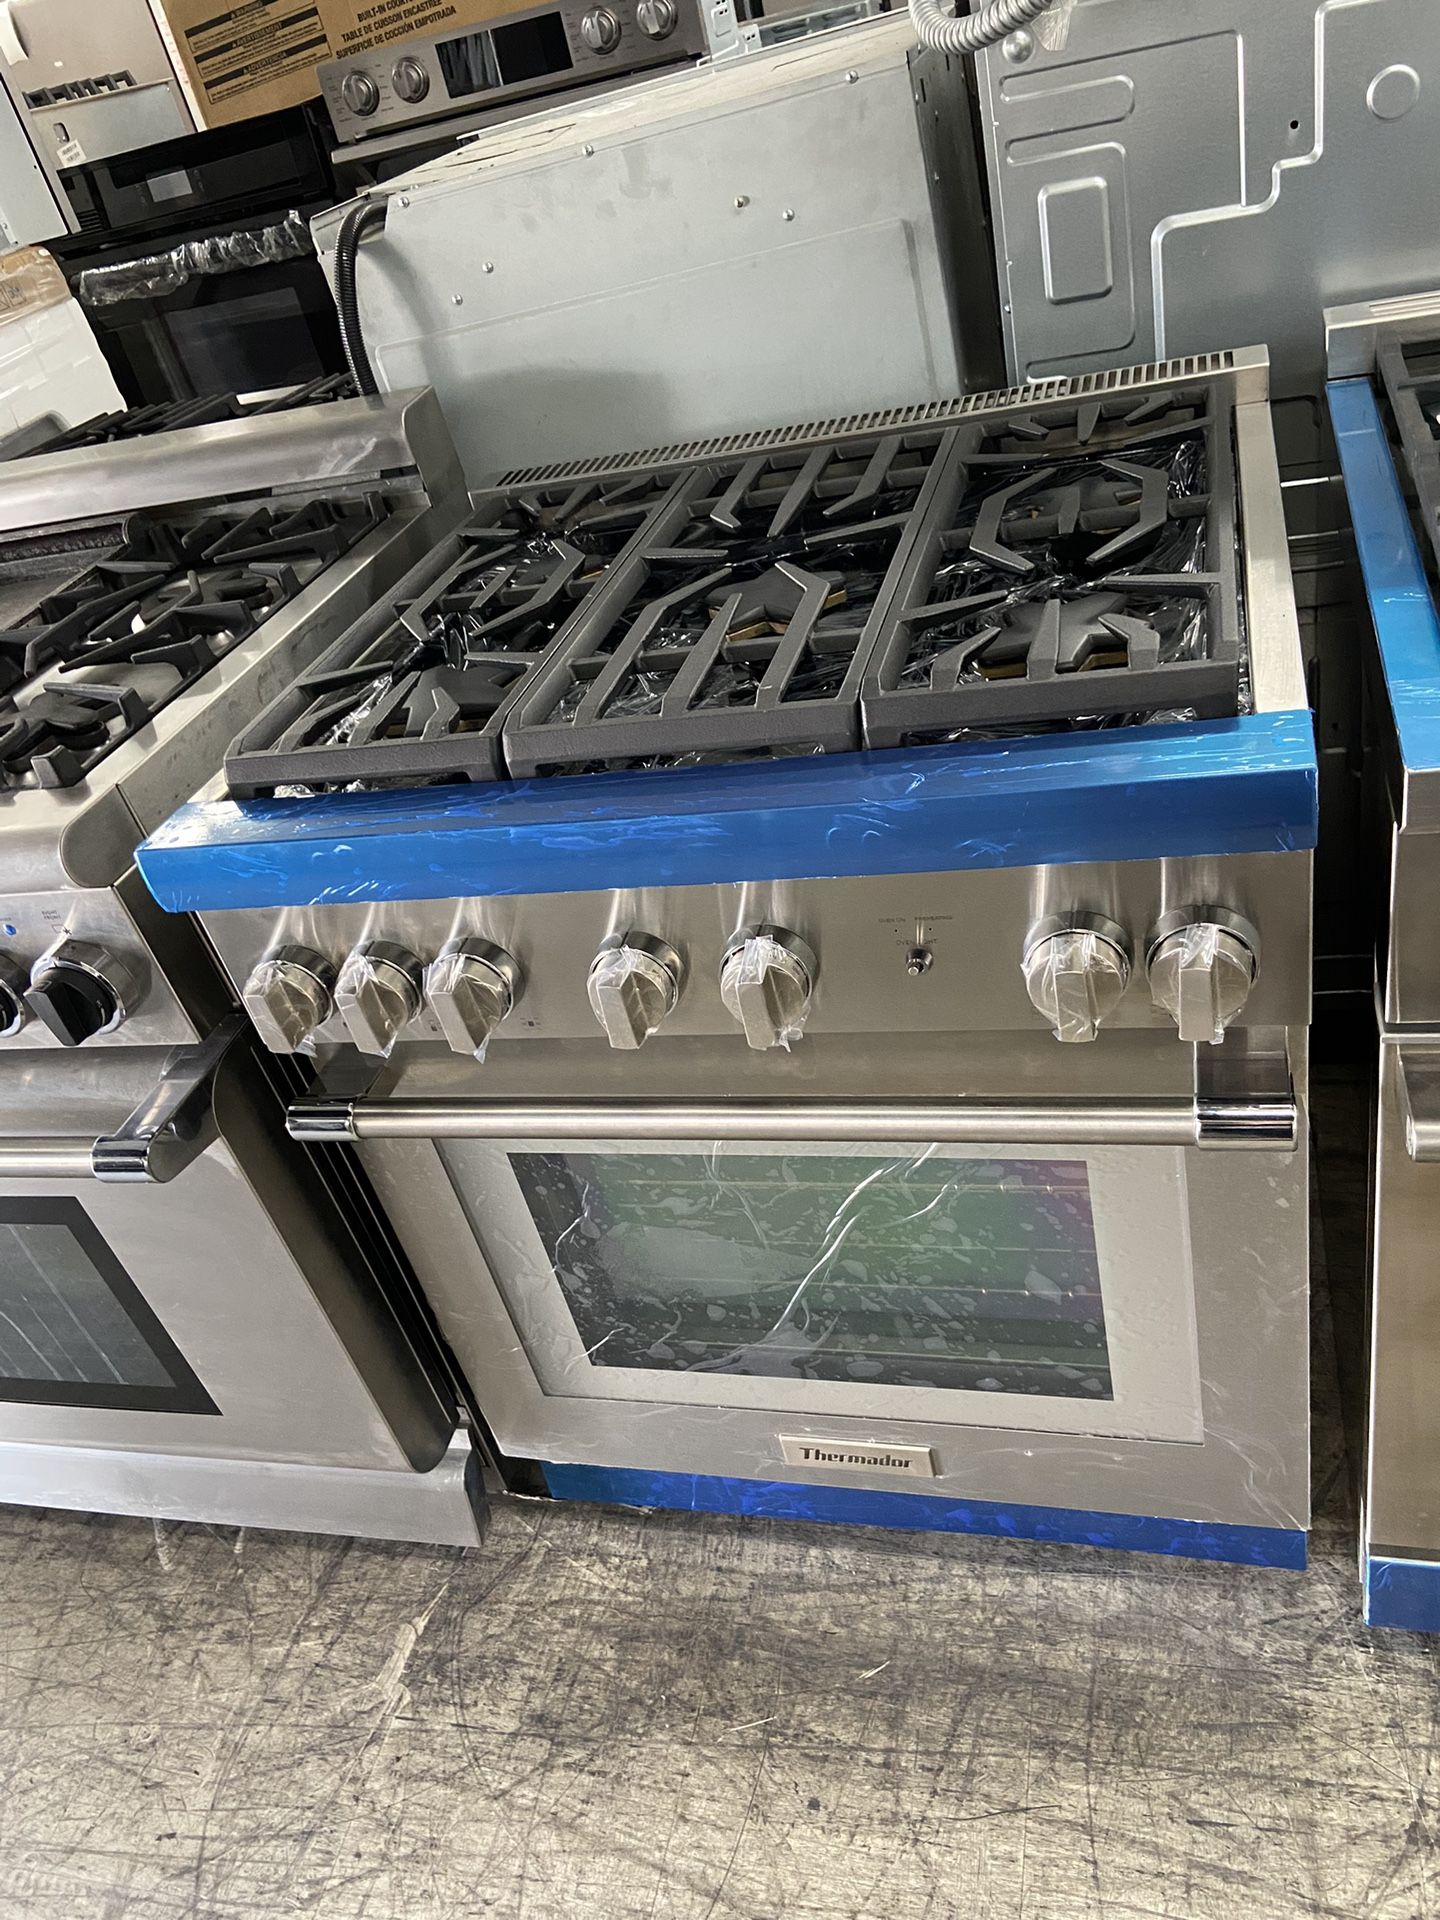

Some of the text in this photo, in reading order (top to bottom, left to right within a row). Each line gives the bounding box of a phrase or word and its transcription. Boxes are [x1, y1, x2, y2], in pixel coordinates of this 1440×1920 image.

[357, 6, 387, 22] BUILT-IN
[336, 5, 457, 60] SUPERFICIE DE COCCIÓN EMPOTRADA
[341, 28, 363, 43] TABLE
[363, 24, 374, 34] DE
[373, 12, 403, 30] CUISSON
[799, 1447, 913, 1468] Thermador
